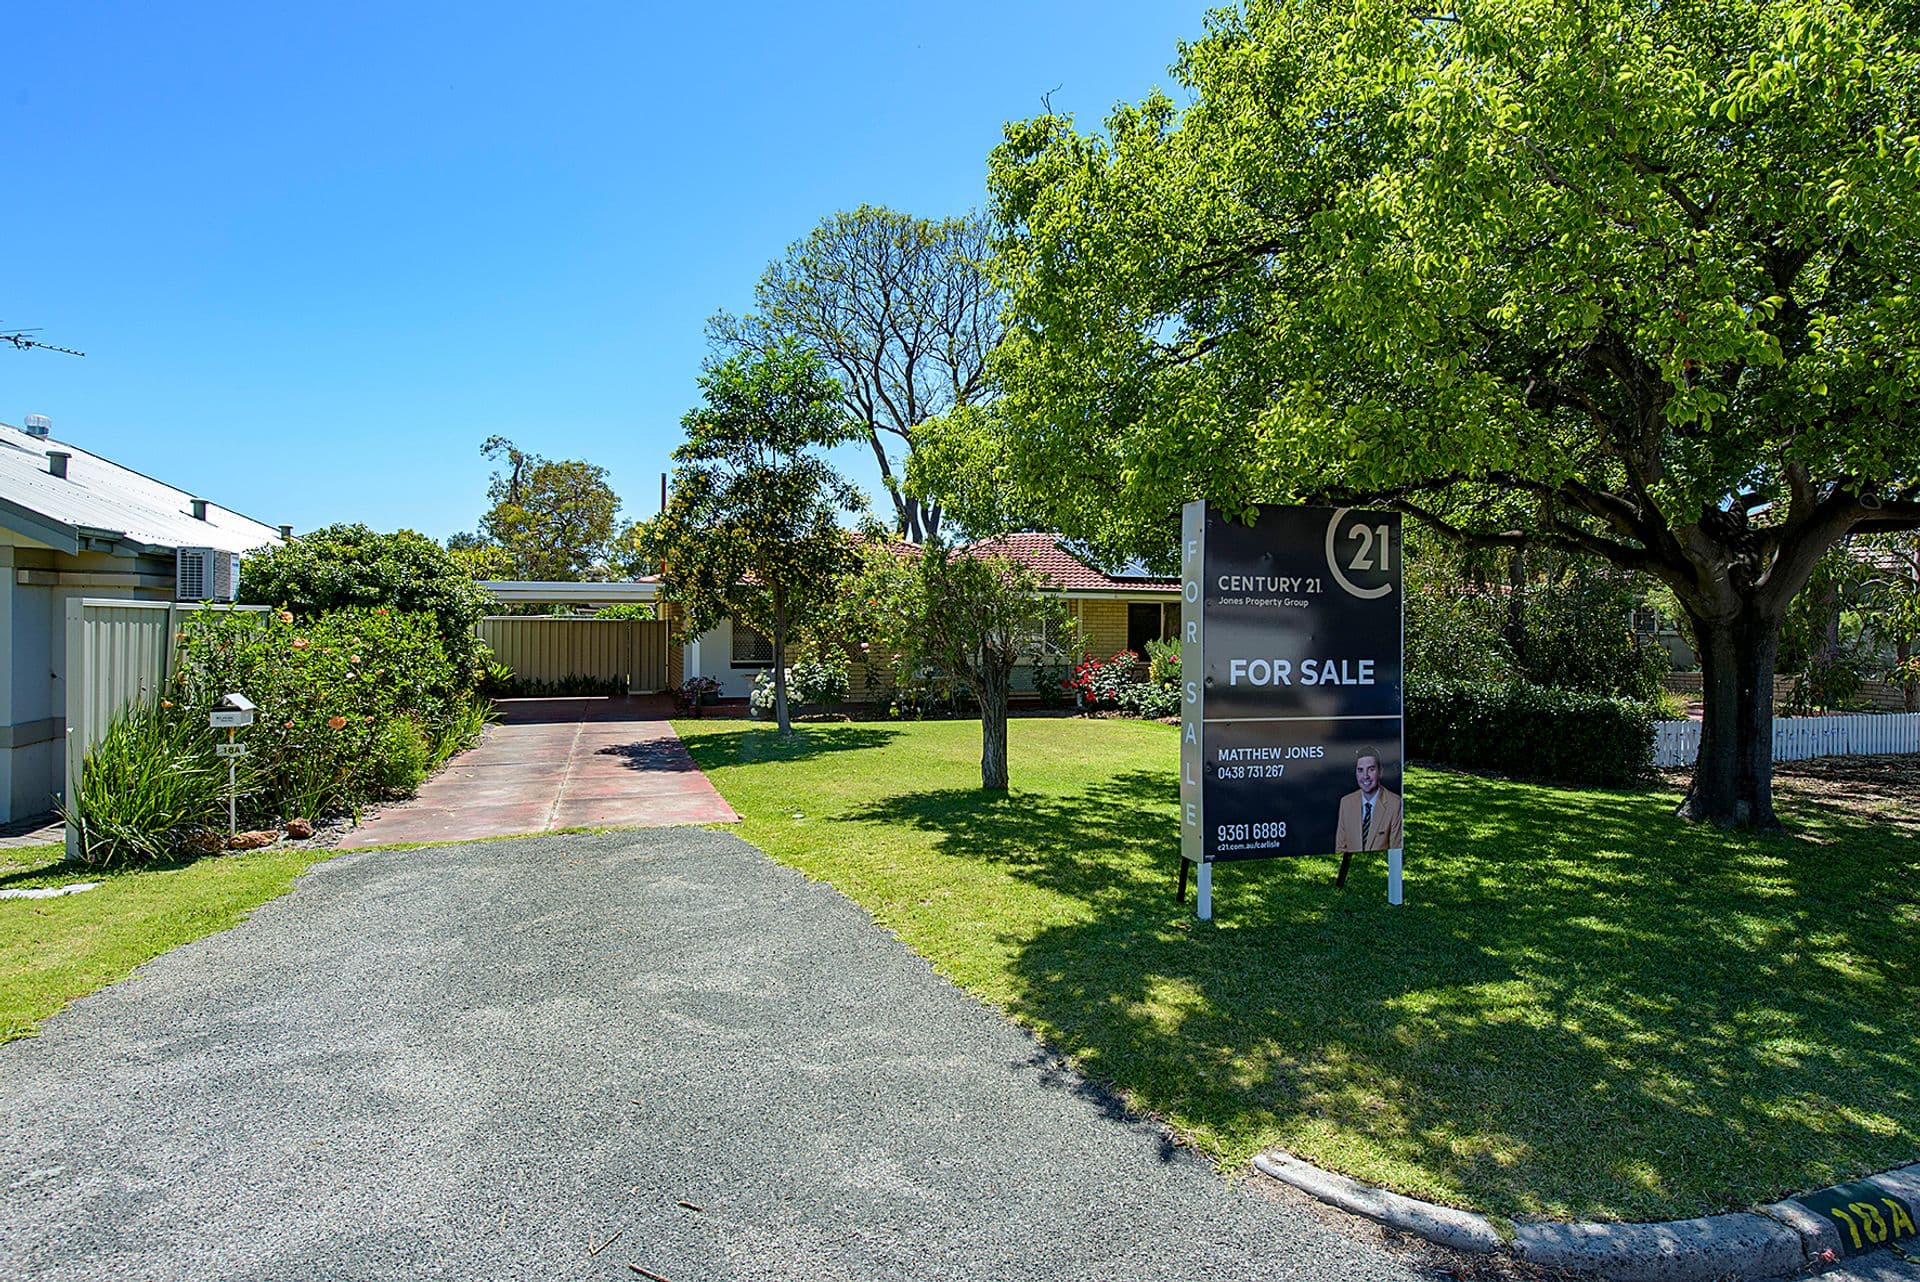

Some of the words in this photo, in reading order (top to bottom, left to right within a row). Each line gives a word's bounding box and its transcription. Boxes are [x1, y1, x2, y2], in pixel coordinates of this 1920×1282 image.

[1348, 523, 1389, 571] 21
[1218, 575, 1301, 593] CENTURY
[1218, 596, 1243, 605] Jones
[1245, 597, 1282, 607] Property
[1284, 599, 1309, 608] Group
[1229, 659, 1292, 686] FOR
[1300, 659, 1375, 686] SALE
[1218, 748, 1281, 761] MATTHEW
[1285, 746, 1324, 759] JONES
[1218, 766, 1244, 779] 0438
[1247, 766, 1264, 778] 731
[1265, 765, 1284, 777] 267
[1217, 825, 1249, 841] 9361
[1252, 822, 1286, 839] 6888
[1217, 841, 1280, 851] c21.com.au/carlisle
[1831, 1198, 1916, 1249] 18A
